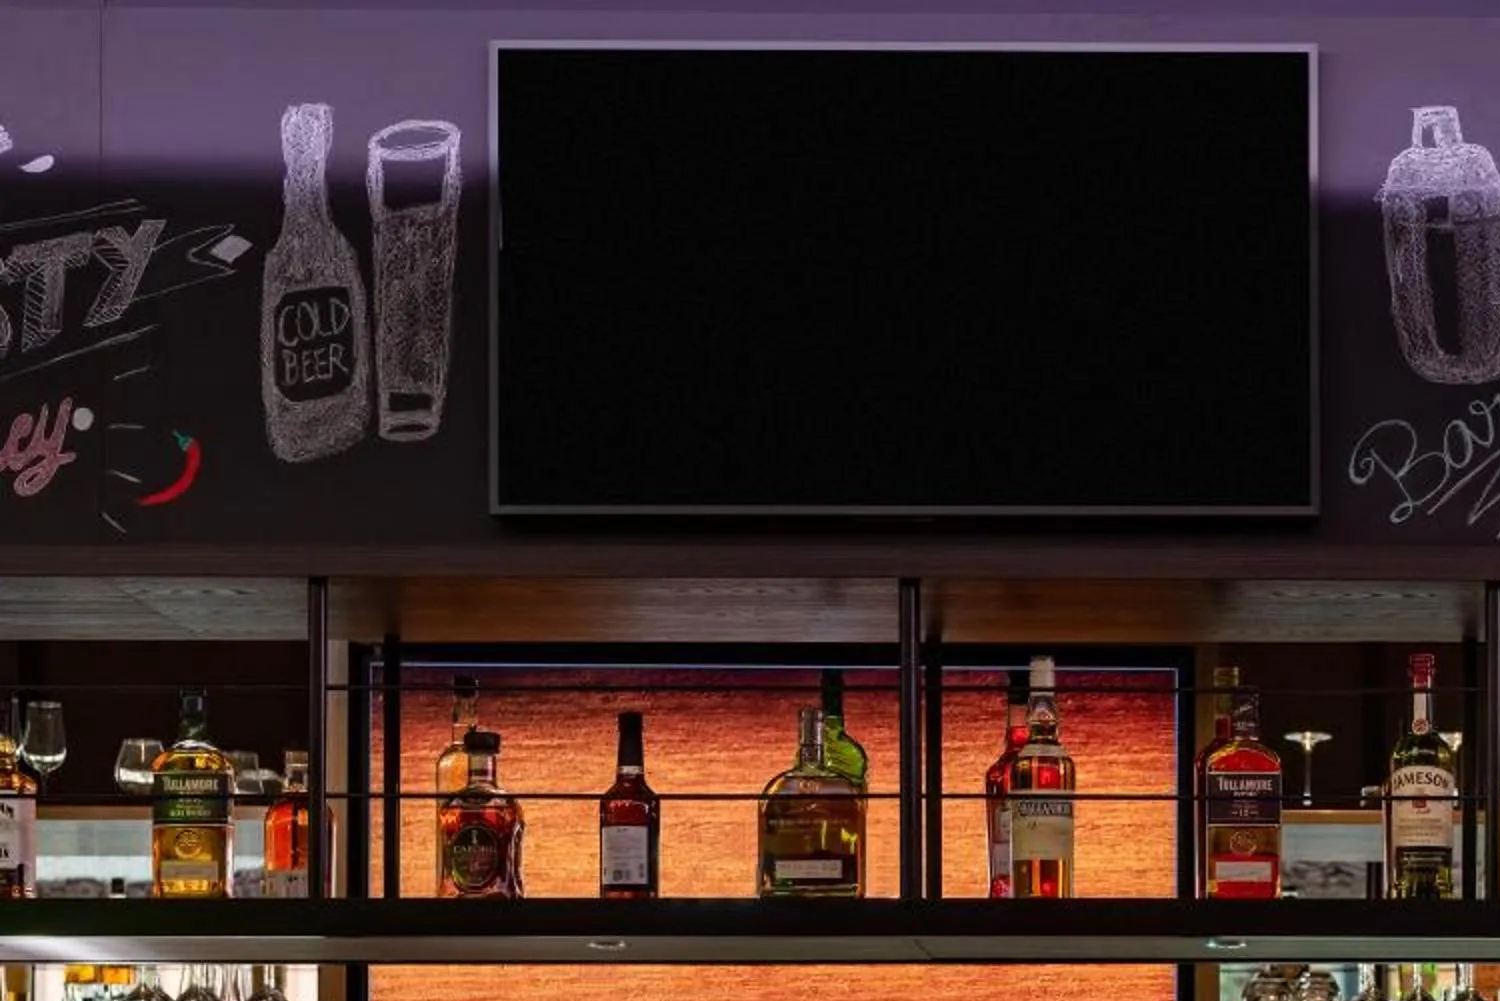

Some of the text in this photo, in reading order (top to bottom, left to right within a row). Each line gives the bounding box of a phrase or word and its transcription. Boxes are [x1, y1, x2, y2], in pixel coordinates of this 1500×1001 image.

[0, 219, 167, 353] TY
[278, 298, 350, 346] COLD
[282, 344, 349, 386] BEER
[1217, 775, 1273, 792] TULLAMORE
[1393, 771, 1450, 791] JAMESON
